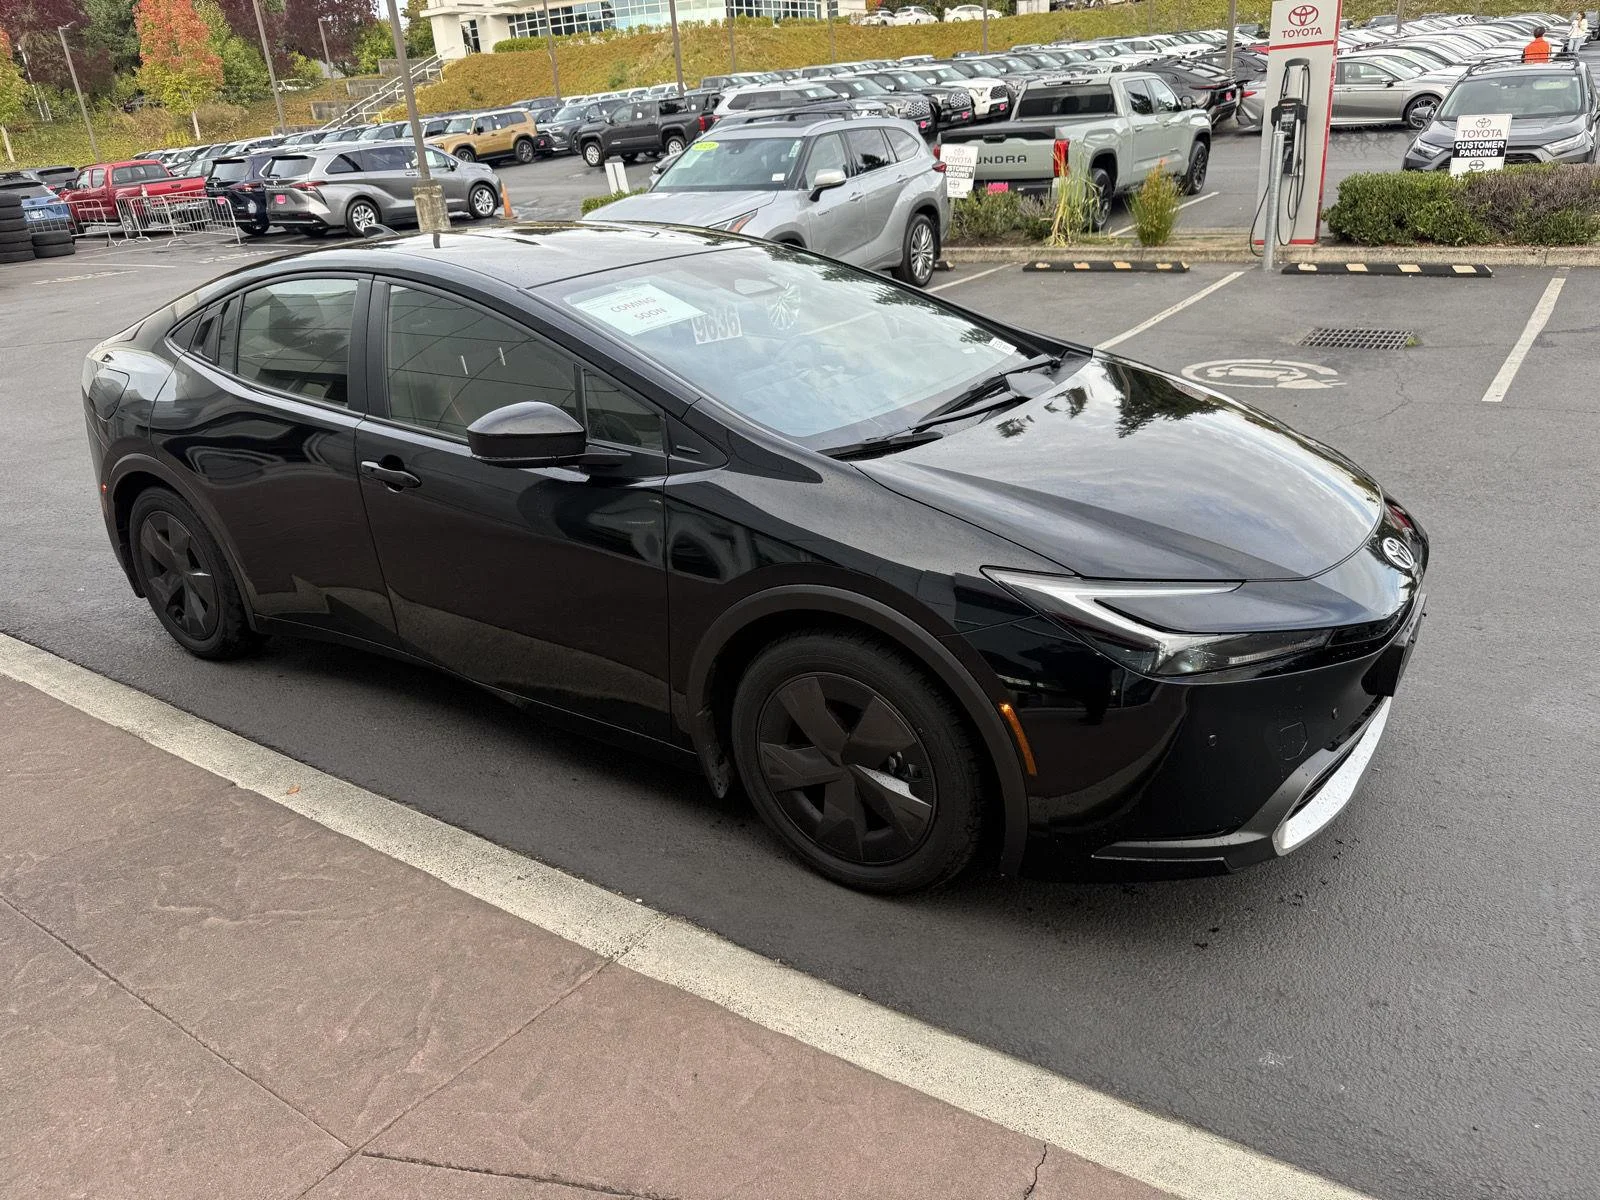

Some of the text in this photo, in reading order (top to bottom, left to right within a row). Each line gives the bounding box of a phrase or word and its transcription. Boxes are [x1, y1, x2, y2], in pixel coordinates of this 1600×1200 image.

[1282, 27, 1322, 38] TOYOTA
[1461, 129, 1503, 138] TOYOTA
[1455, 141, 1505, 149] CUSTOMER
[1458, 149, 1498, 157] PARKING
[945, 155, 972, 164] TOYOTA
[976, 155, 1027, 164] UNDRA
[611, 296, 657, 312] COMING
[634, 308, 667, 320] SOON
